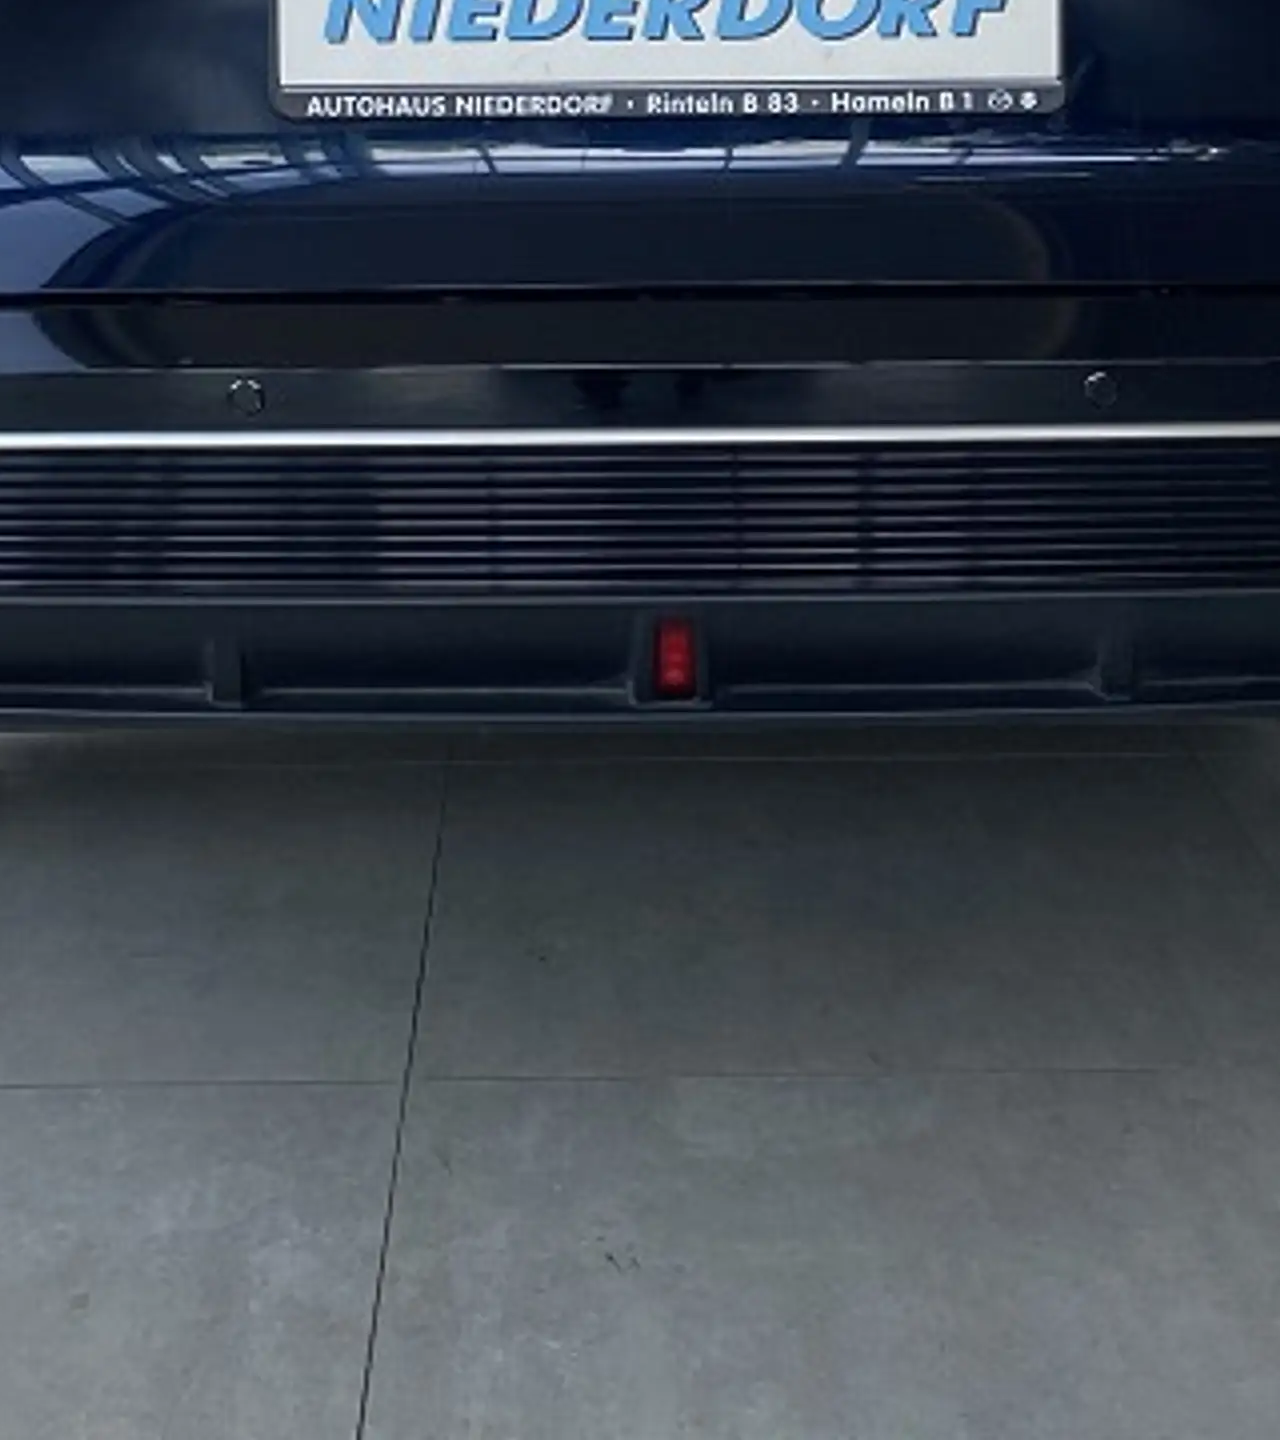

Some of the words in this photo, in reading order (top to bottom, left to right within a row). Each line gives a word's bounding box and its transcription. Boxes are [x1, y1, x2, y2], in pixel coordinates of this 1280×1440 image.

[306, 95, 446, 118] AUTOHAUS
[455, 93, 614, 117] NIEDERDORF
[646, 92, 734, 115] Rinteln
[742, 92, 759, 114] B
[767, 91, 800, 114] 83
[939, 91, 956, 112] B
[962, 91, 974, 111] 1
